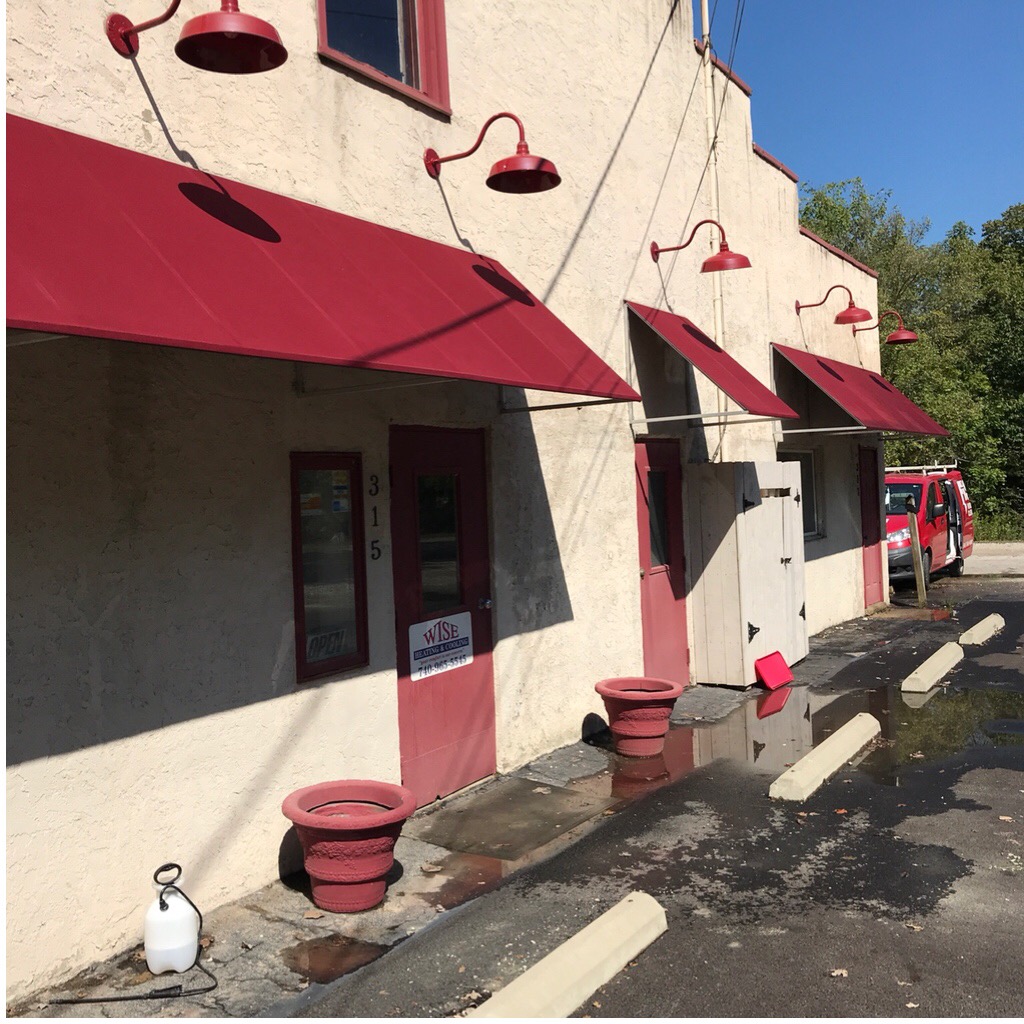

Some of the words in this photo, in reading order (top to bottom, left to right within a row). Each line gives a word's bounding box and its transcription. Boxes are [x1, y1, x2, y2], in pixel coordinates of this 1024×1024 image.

[309, 629, 346, 658] OPEN
[423, 621, 459, 645] WISE
[414, 647, 439, 660] HEATING
[446, 638, 468, 650] COOLING
